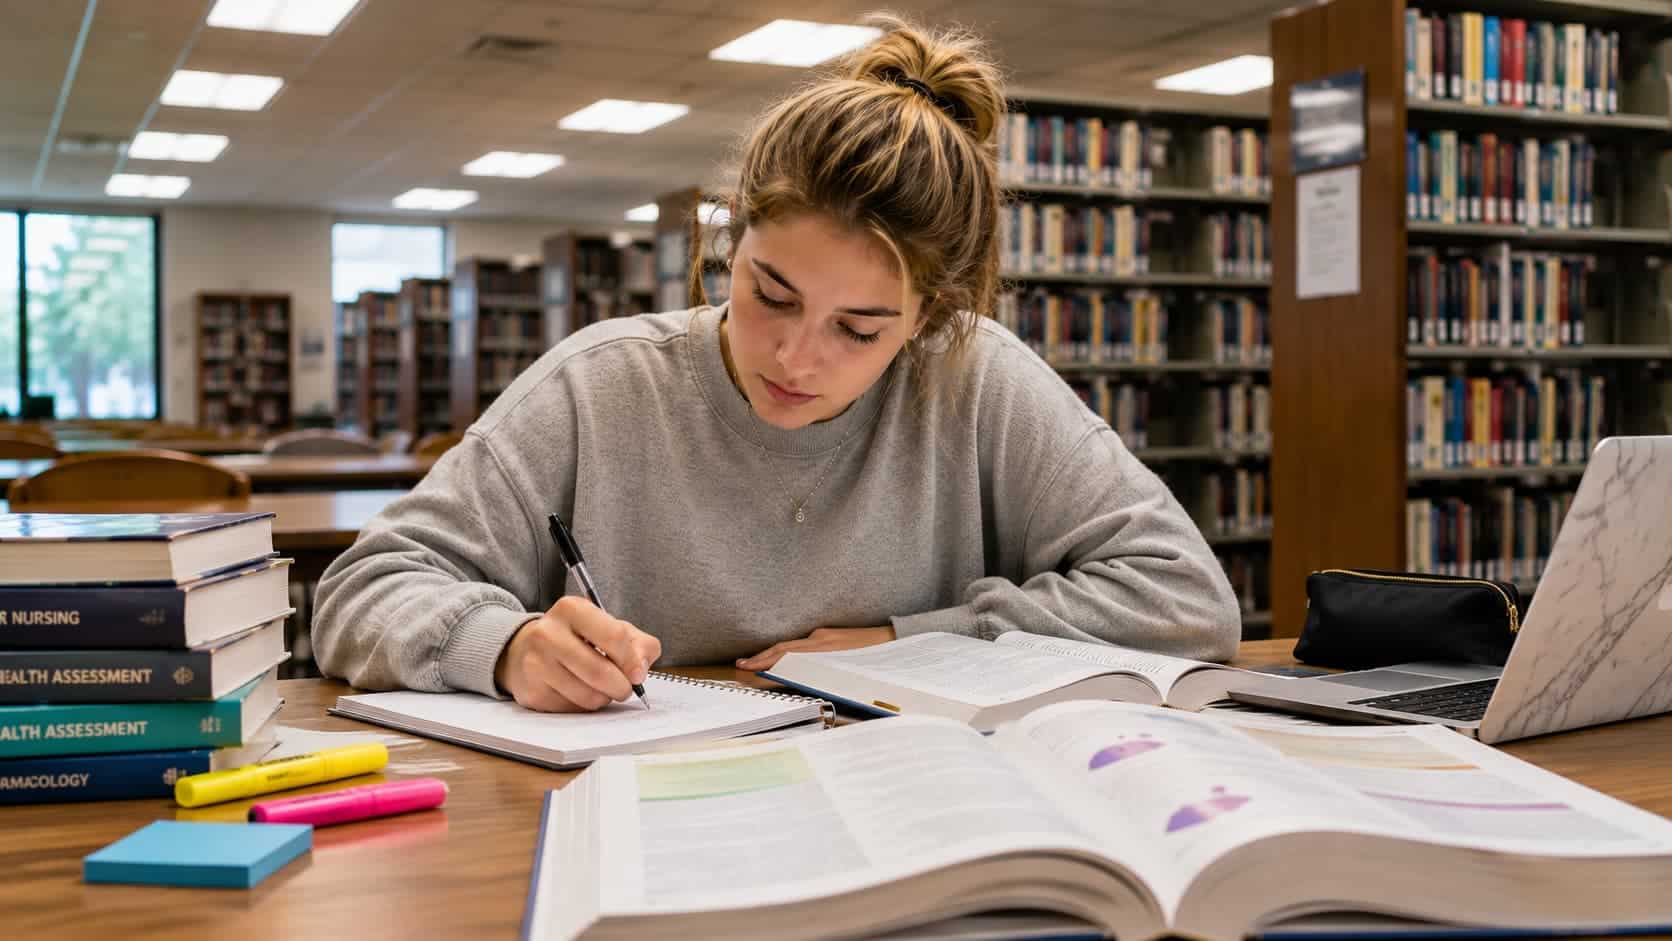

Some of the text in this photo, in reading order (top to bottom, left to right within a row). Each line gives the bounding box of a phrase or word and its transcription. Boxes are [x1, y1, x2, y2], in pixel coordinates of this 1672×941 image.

[12, 610, 80, 625] NURSING
[52, 669, 152, 684] ASSESSMENT
[45, 721, 148, 738] ASSESSMENT
